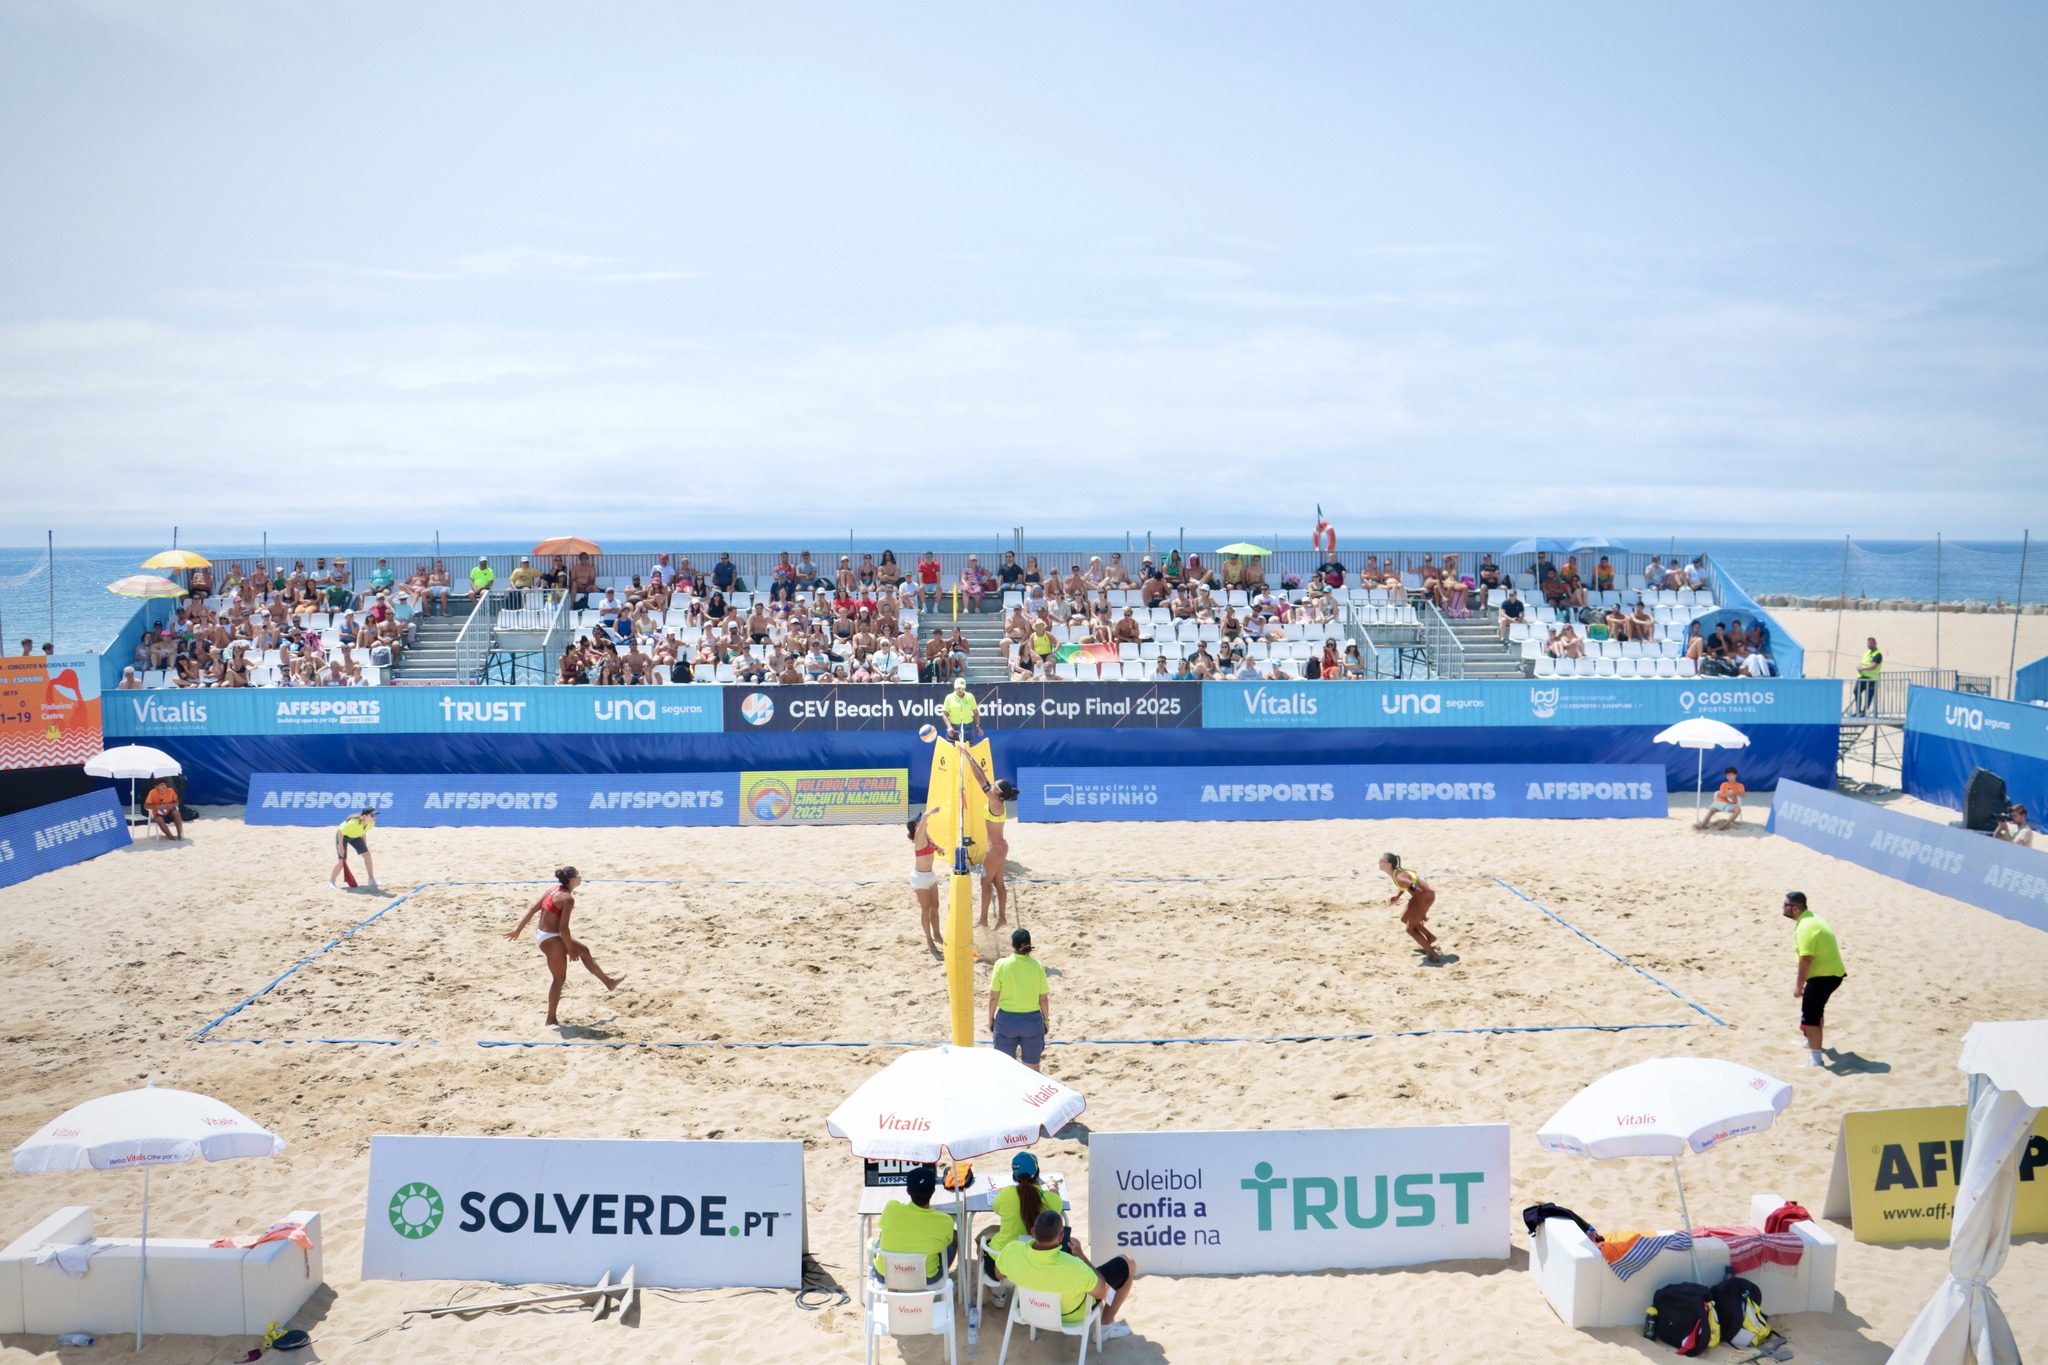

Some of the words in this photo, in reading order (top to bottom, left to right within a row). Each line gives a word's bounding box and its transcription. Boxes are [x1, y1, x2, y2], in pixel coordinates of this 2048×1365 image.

[1243, 686, 1318, 715] Vitalis
[1382, 693, 1441, 714] una
[1446, 699, 1485, 710] seguros
[1697, 691, 1774, 704] cosmos
[132, 695, 208, 723] Vitalis
[277, 700, 380, 715] AFFSPORTS
[439, 696, 526, 721] TRUST
[594, 699, 656, 721] una
[661, 705, 702, 716] seguros
[789, 700, 830, 718] CEV
[834, 699, 894, 717] Beach
[898, 699, 944, 717] Volle
[976, 698, 1036, 717] ations
[1041, 698, 1080, 719] Cup
[1085, 697, 1131, 715] Final
[1136, 697, 1181, 715] 2025
[1945, 704, 1983, 731] una
[1984, 718, 2011, 730] seguros
[797, 778, 845, 792] VOLEIBOL
[847, 778, 861, 791] DE
[862, 777, 896, 790] PRAIA
[1200, 783, 1335, 802] AFFSPORTS
[1365, 782, 1496, 801] AFFSPORTS
[1526, 782, 1653, 800] AFFSPORTS
[262, 791, 394, 809] AFFSPORTS
[424, 791, 558, 809] AFFSPORTS
[589, 790, 724, 809] AFFSPORTS
[793, 791, 845, 805] CIRCUITO
[846, 790, 900, 804] NACIONAL
[1076, 792, 1158, 805] ESPINHO
[793, 805, 826, 819] 2025
[1778, 800, 1855, 840] AFFSPORTS
[34, 809, 118, 851] AFFSPORTS
[1870, 830, 1965, 874] AFFSPORTS
[1023, 1085, 1058, 1107] Vitalis
[200, 1117, 238, 1126] Vitalis
[879, 1112, 931, 1131] Vitalis
[1617, 1113, 1657, 1127] Vitalis
[1004, 1133, 1028, 1144] Vitalis
[126, 1154, 146, 1162] Vitalis
[1116, 1168, 1202, 1191] Voleibol
[1241, 1162, 1485, 1231] TRUST
[459, 1191, 779, 1237] SOLVERDE.PT
[1117, 1197, 1187, 1218] confia
[1194, 1202, 1207, 1217] a
[1117, 1224, 1187, 1246] saúde
[1194, 1229, 1222, 1246] na
[894, 1264, 916, 1272] Vitalis
[1029, 1298, 1050, 1308] Vitalis
